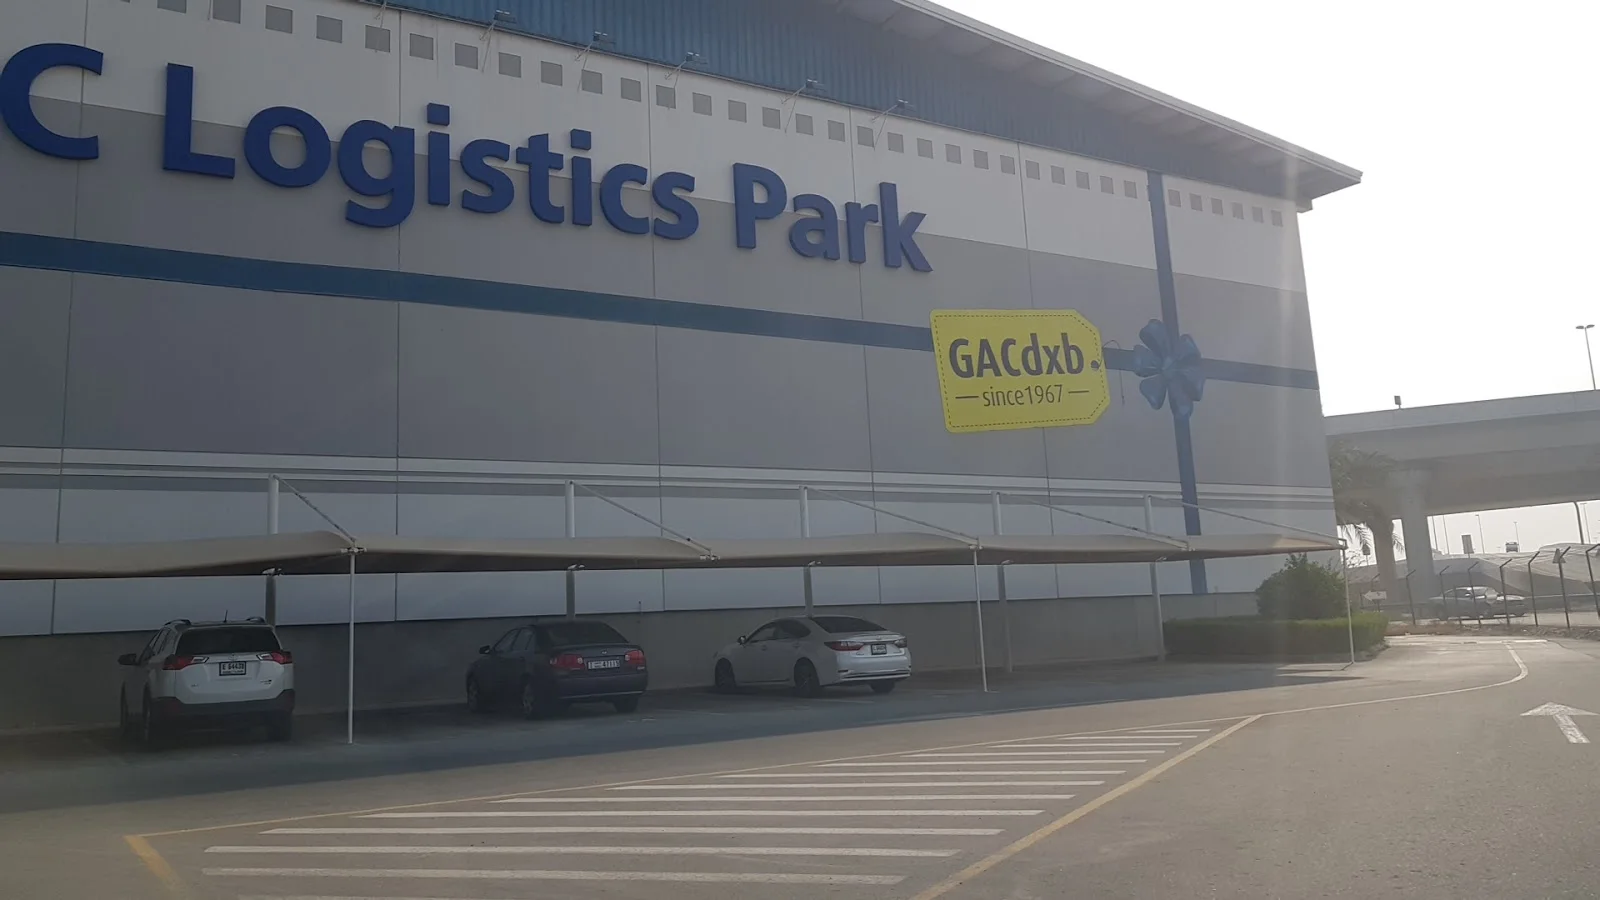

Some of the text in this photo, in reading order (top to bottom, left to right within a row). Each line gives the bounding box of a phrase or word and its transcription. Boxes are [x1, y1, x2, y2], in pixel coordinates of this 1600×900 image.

[0, 42, 934, 273] C Logistics Park
[949, 332, 1085, 379] GACdxb
[983, 384, 1063, 407] since1967
